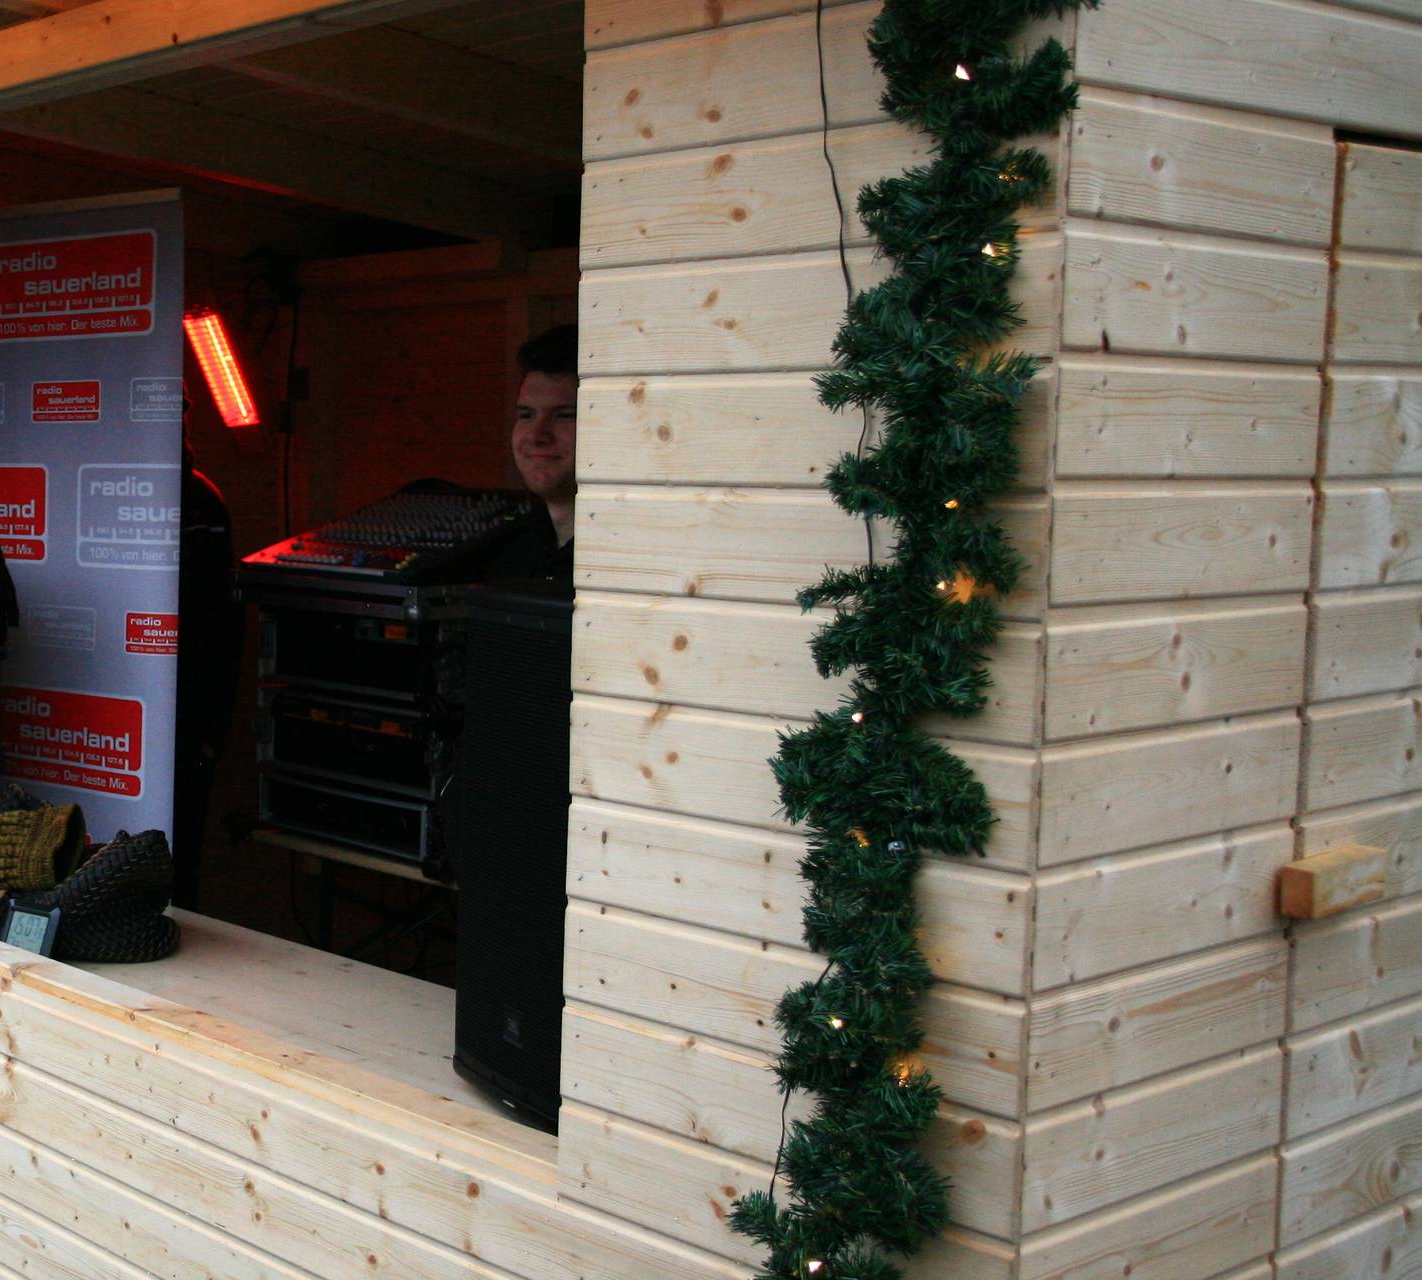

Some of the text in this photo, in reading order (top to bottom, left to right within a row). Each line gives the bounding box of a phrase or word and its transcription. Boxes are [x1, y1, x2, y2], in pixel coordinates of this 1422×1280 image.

[24, 267, 142, 296] sauerland
[29, 323, 45, 334] von
[71, 318, 90, 331] Der
[90, 317, 116, 329] beste
[120, 316, 139, 327] Mix.
[36, 386, 63, 395] radio
[136, 383, 167, 392] radio
[48, 395, 96, 405] sauerland
[90, 476, 154, 497] radio
[130, 617, 162, 626] radio
[19, 723, 130, 753] sauerland
[64, 769, 80, 781] Der
[82, 772, 107, 787] beste
[109, 776, 130, 791] Mix.
